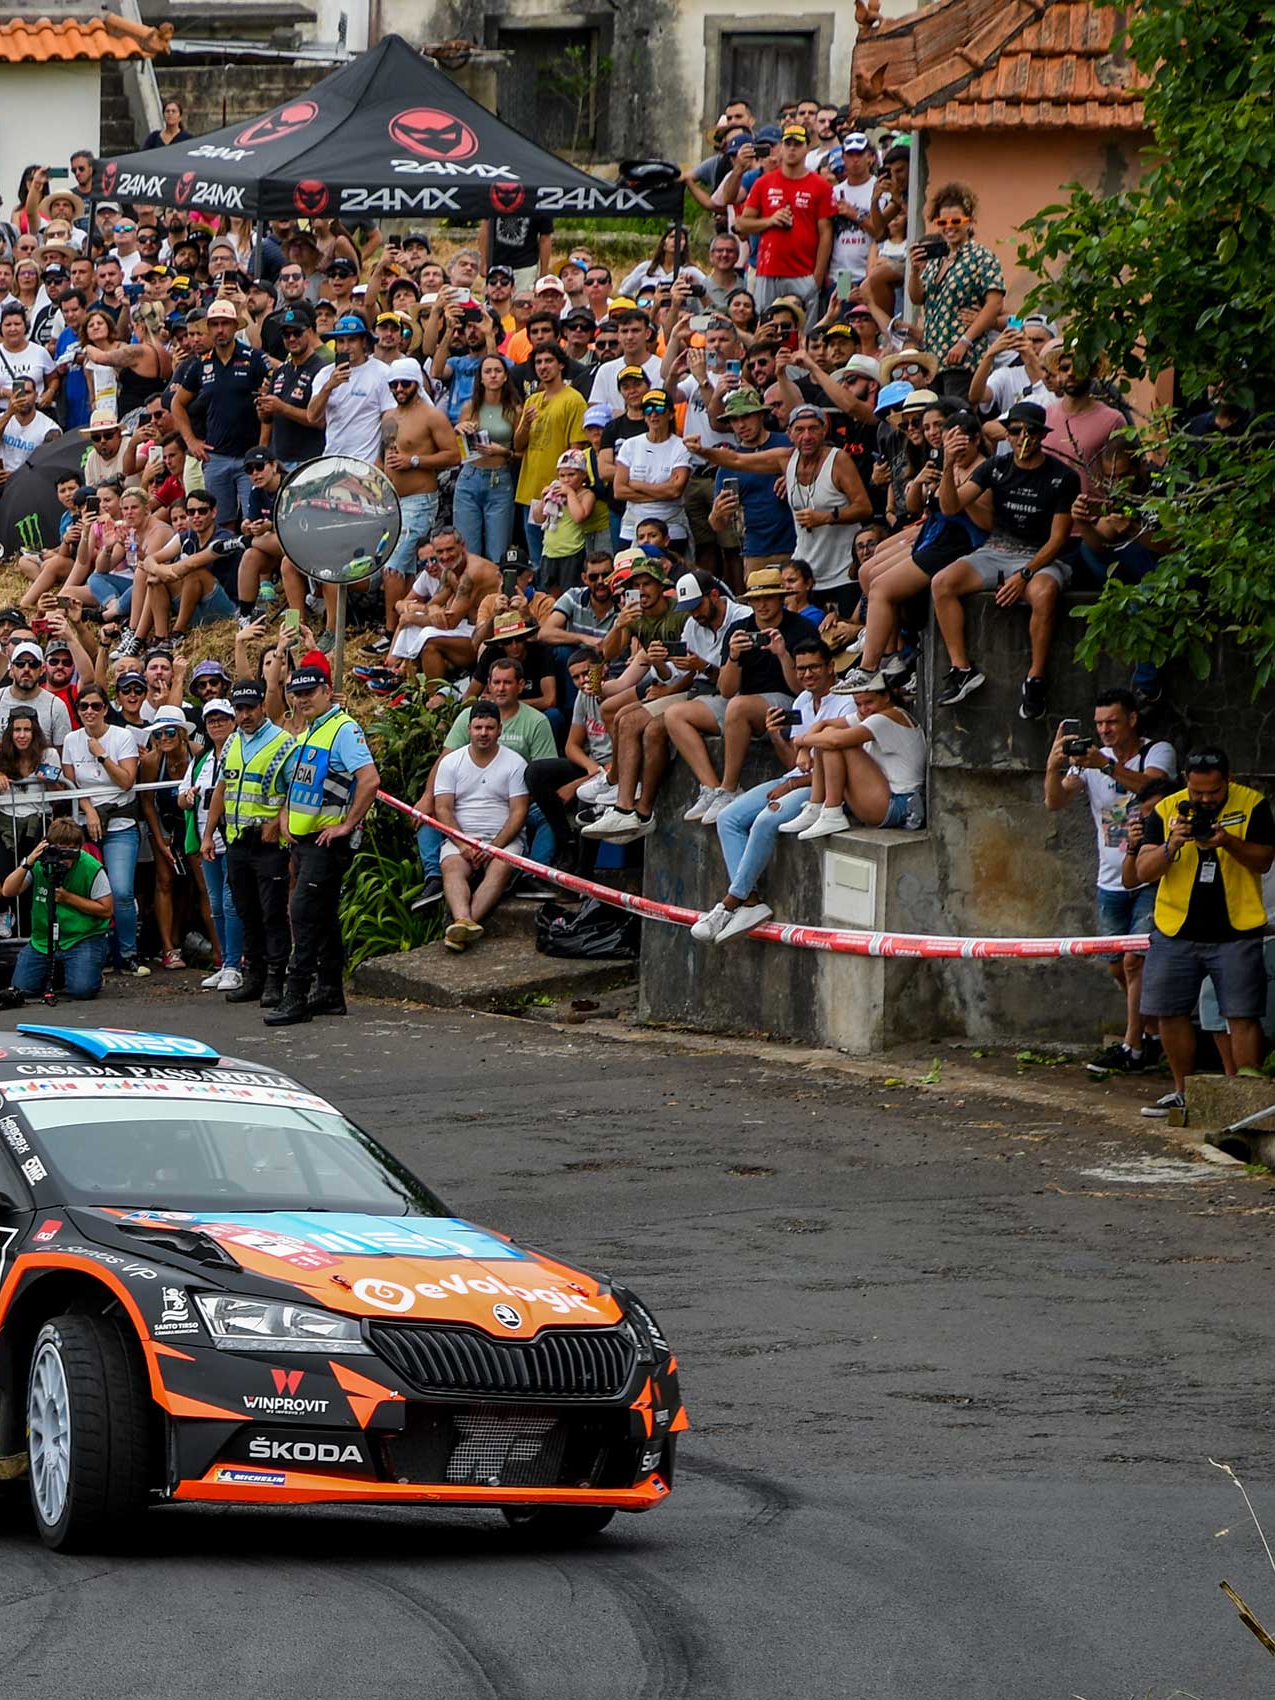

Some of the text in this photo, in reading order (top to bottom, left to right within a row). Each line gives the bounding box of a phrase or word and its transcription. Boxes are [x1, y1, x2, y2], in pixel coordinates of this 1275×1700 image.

[390, 159, 520, 180] 24MX
[117, 174, 167, 198] 24MX
[192, 182, 246, 210] 24MX
[339, 186, 462, 211] 24MX
[535, 186, 655, 211] 24MX
[16, 1064, 300, 1090] CASA DA PASSARELLA
[24, 1158, 45, 1182] OMP
[63, 1246, 124, 1264] Santos
[122, 1263, 158, 1280] VP
[414, 1273, 601, 1314] evologic
[154, 1322, 199, 1331] SANTO TIRSO
[243, 1395, 329, 1413] WINPROVIT
[249, 1436, 364, 1463] ŠKODA
[233, 1474, 285, 1483] MICHELIN
